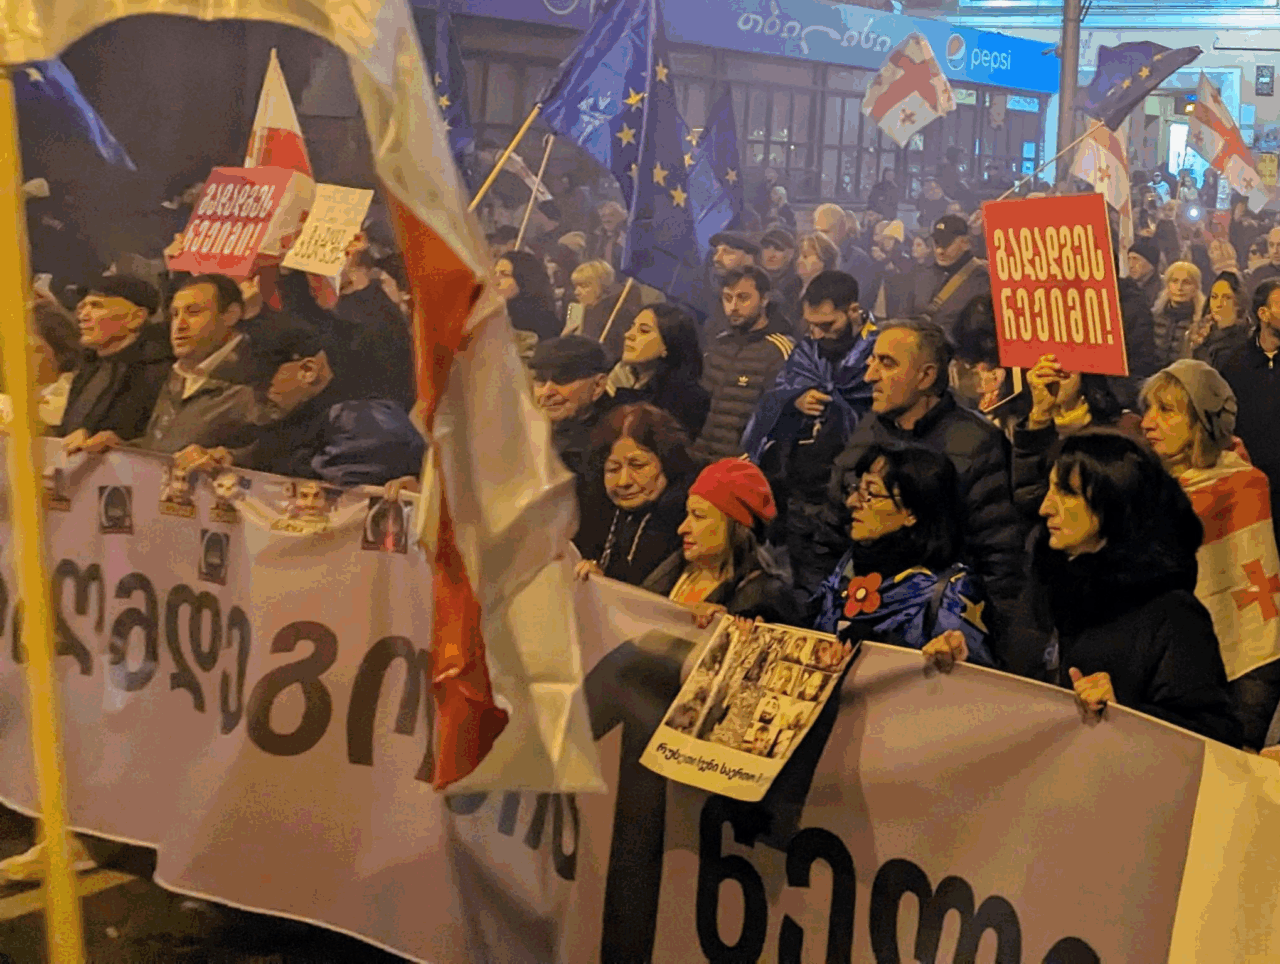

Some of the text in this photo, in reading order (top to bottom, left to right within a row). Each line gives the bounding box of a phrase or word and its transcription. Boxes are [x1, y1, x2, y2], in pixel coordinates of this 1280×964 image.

[970, 48, 1012, 73] pepsi
[197, 183, 276, 218] გადადგეს
[182, 219, 263, 257] რეჟიმი!
[993, 223, 1105, 282] გადადგეს
[1000, 287, 1115, 346] რეჟიმი!
